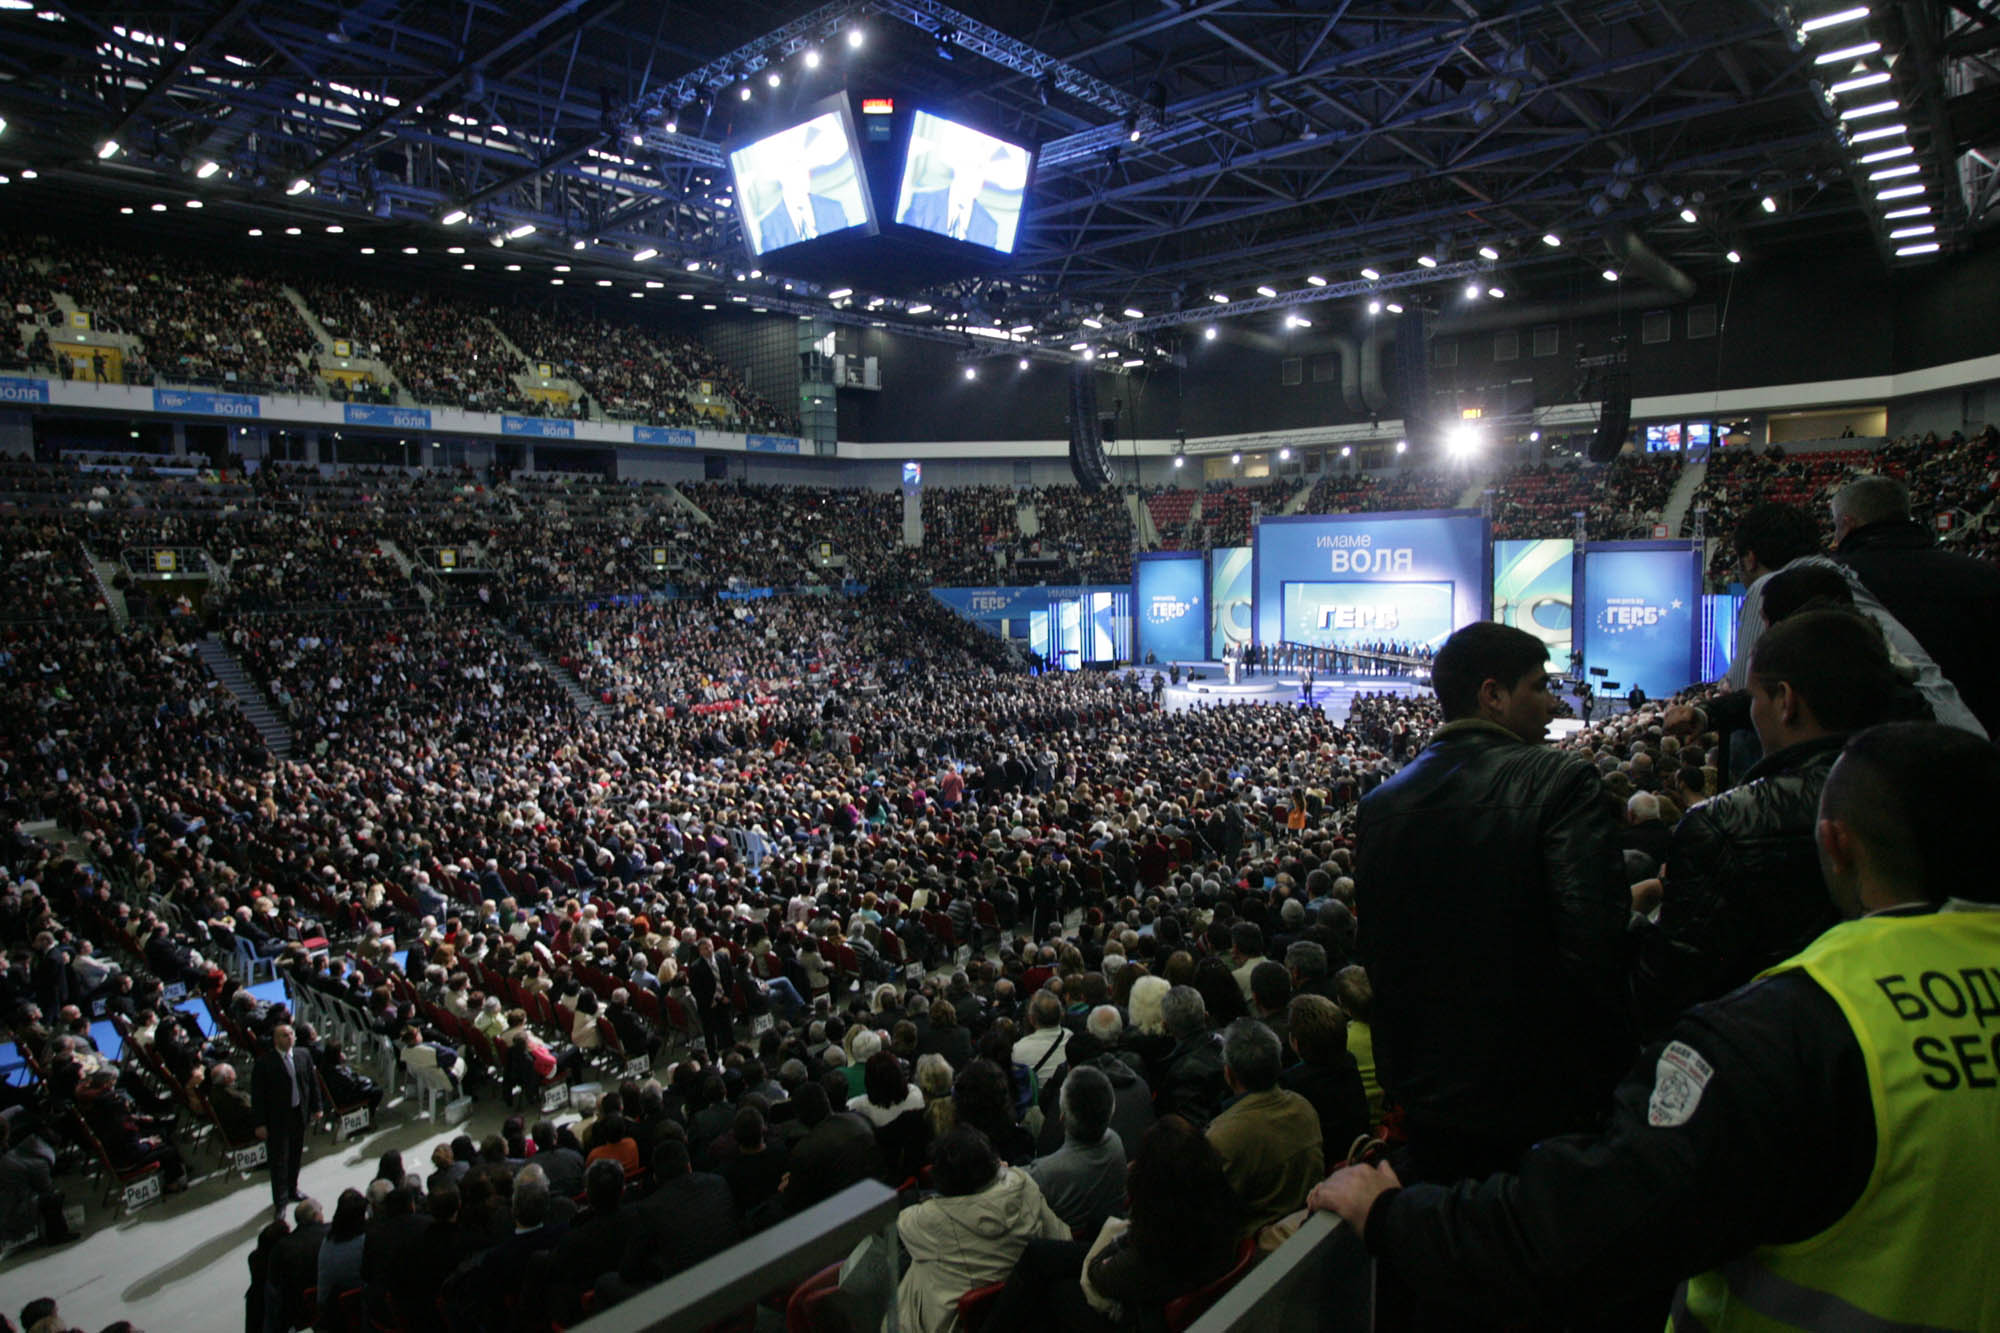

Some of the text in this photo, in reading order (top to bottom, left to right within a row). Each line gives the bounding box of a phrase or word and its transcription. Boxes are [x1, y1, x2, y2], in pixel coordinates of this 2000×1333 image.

[1330, 548, 1413, 573] ВОЛЯ
[972, 597, 1006, 610] ГЕРБ
[1152, 602, 1185, 617] ГЕРБ
[1317, 604, 1399, 631] ГЕРБ
[1606, 606, 1658, 625] ГЕРБ
[1875, 968, 2000, 1029] БОД
[1912, 1032, 2000, 1092] SE
[344, 1115, 362, 1130] Ред
[236, 1145, 266, 1168] Ред 2
[127, 1178, 158, 1202] Ред 3
